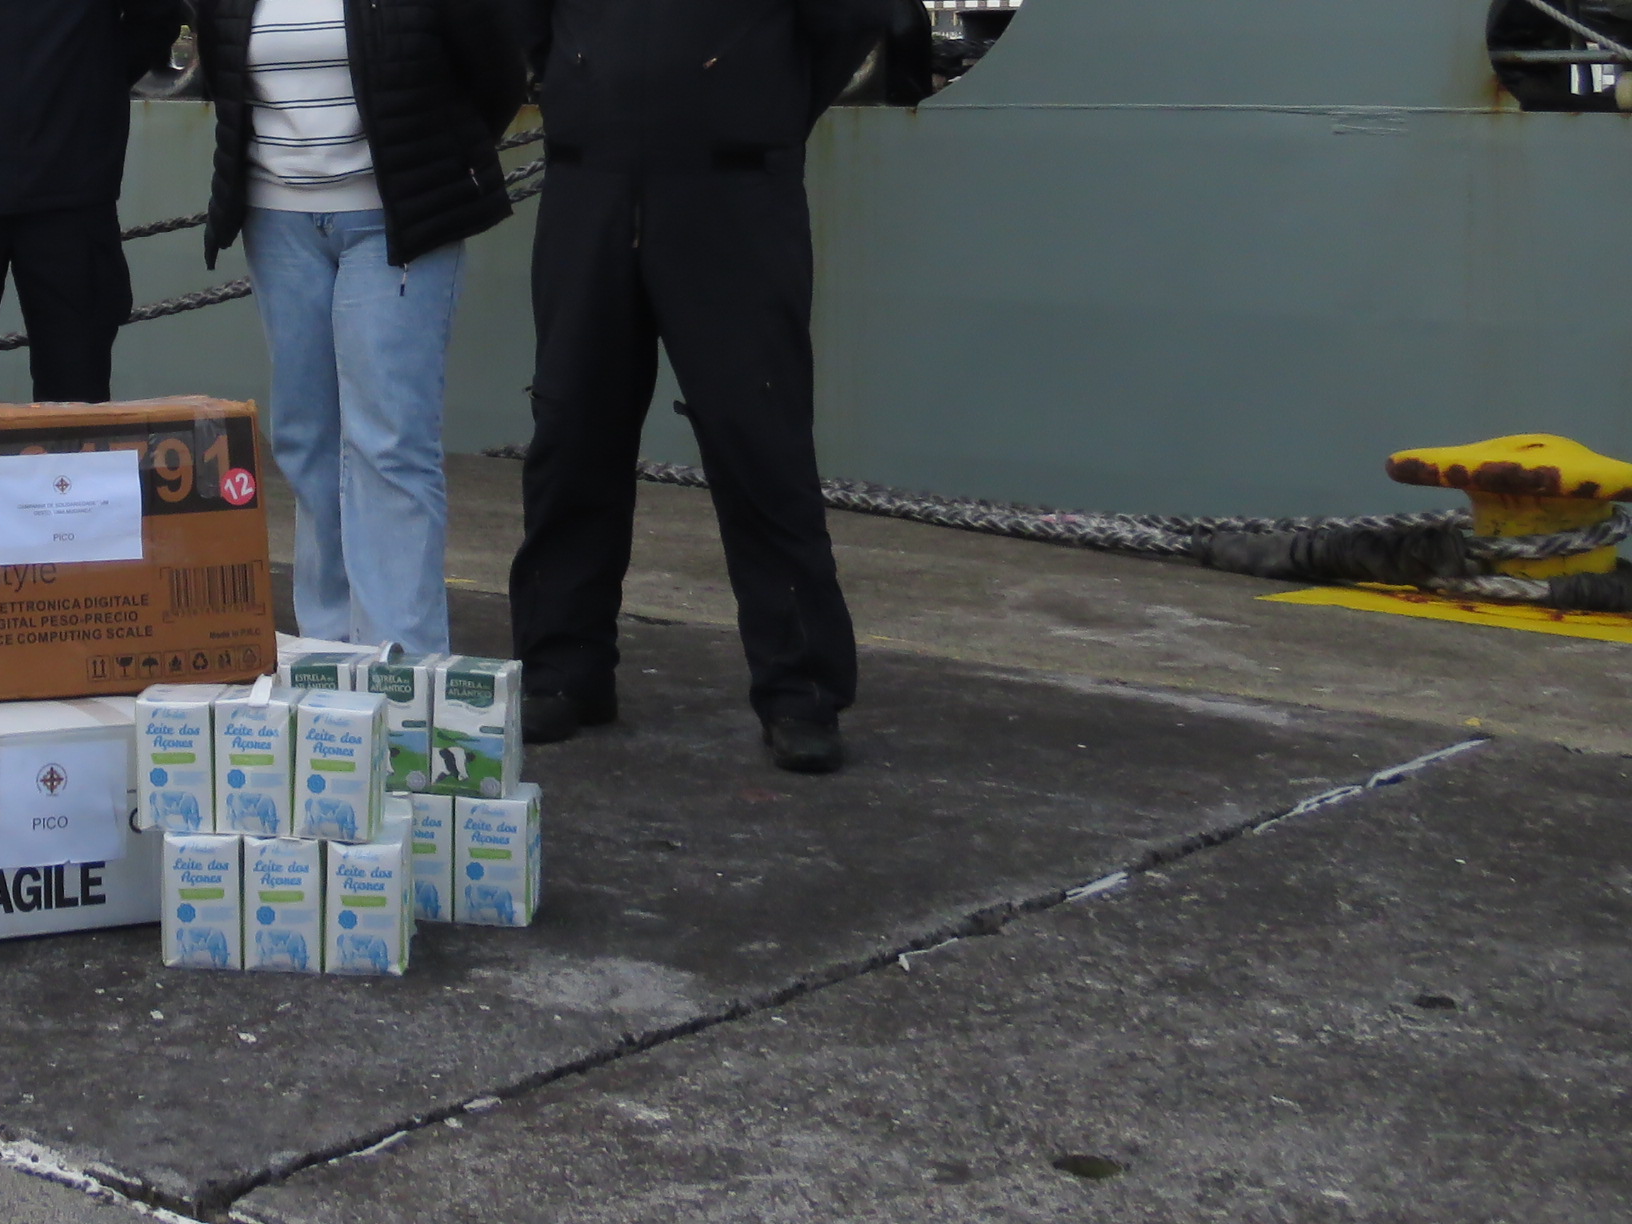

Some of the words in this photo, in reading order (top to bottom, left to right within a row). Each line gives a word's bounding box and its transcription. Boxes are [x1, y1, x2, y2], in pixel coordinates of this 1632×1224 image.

[223, 472, 254, 500] 12
[53, 533, 75, 542] PICO
[83, 594, 150, 609] DIGITALE
[41, 610, 139, 627] PESO-PRECIO
[17, 628, 103, 645] COMPUTING
[106, 625, 154, 640] SCALE
[294, 673, 327, 682] ESTRELA
[449, 678, 483, 689] ESTRELA
[146, 722, 174, 736] Leite
[179, 725, 200, 736] dos
[224, 723, 253, 736] Leite
[258, 726, 279, 737] dos
[305, 728, 336, 742] Leite
[340, 731, 362, 744] dos
[33, 816, 68, 830] PICO
[464, 818, 492, 832] Leite
[496, 821, 517, 833] dos
[173, 858, 203, 871] Leite
[208, 859, 229, 871] dos
[253, 859, 283, 873] Leite
[288, 861, 309, 873] dos
[335, 864, 365, 878] Leite
[371, 867, 393, 879] dos
